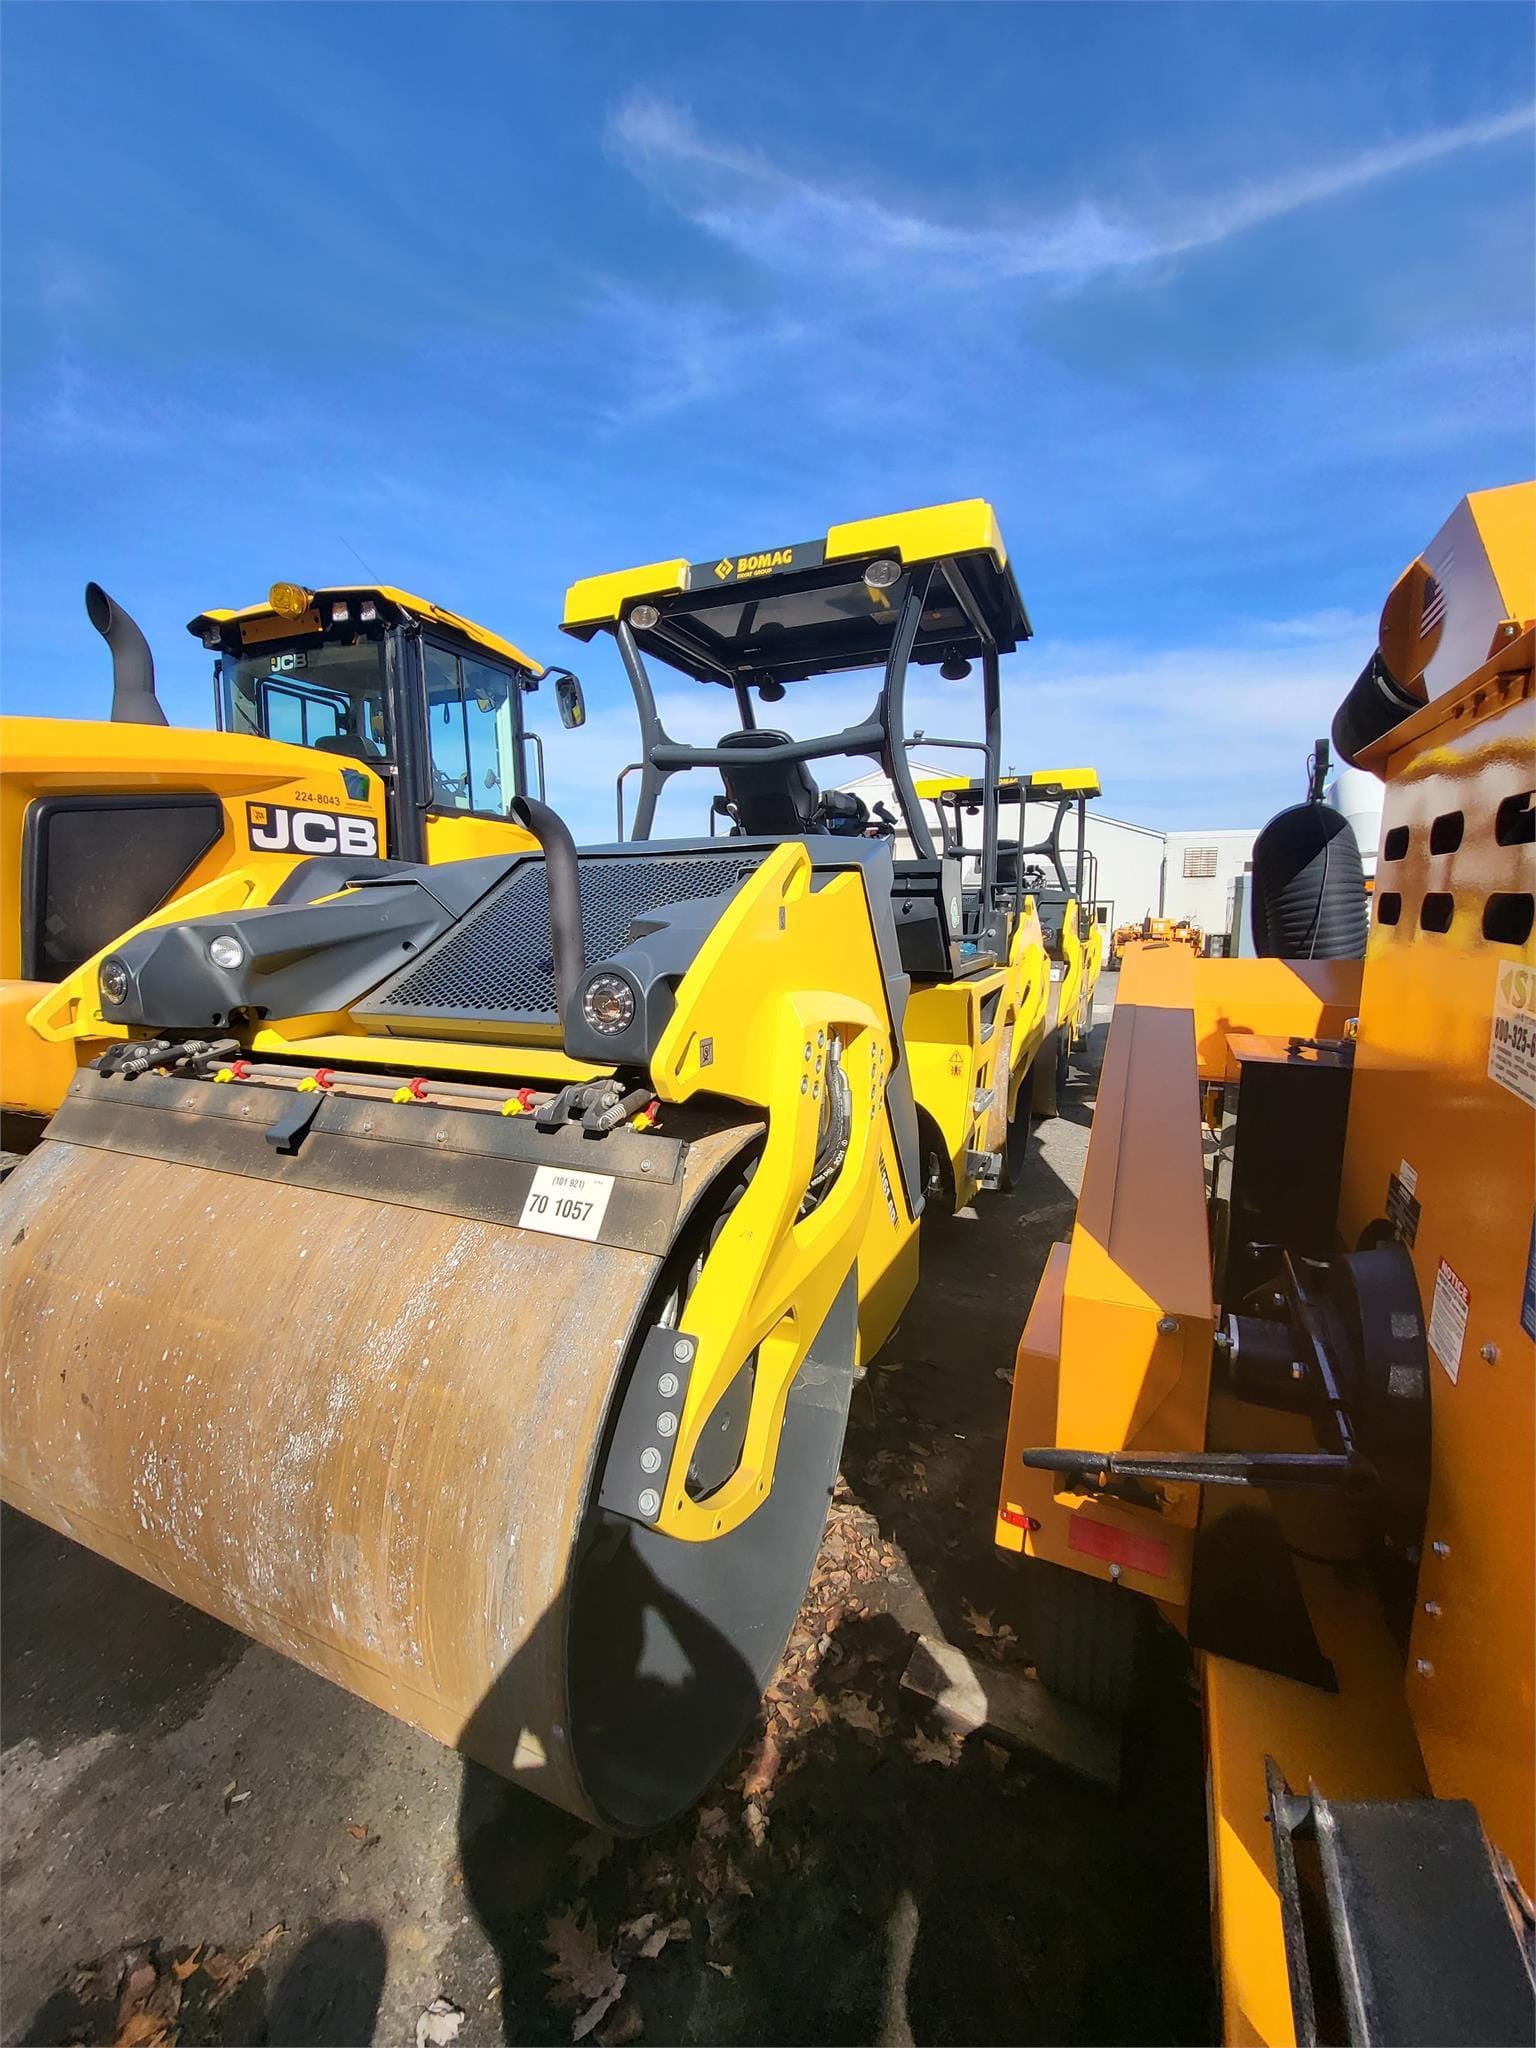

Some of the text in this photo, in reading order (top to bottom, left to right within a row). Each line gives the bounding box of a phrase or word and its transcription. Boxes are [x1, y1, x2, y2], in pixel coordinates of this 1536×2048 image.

[736, 548, 793, 573] BOMAG
[270, 653, 308, 672] JCB
[294, 790, 341, 807] 224-8043
[252, 808, 378, 856] JCB
[528, 1193, 594, 1222] 70 1057
[1440, 1259, 1469, 1302] NOTICE
